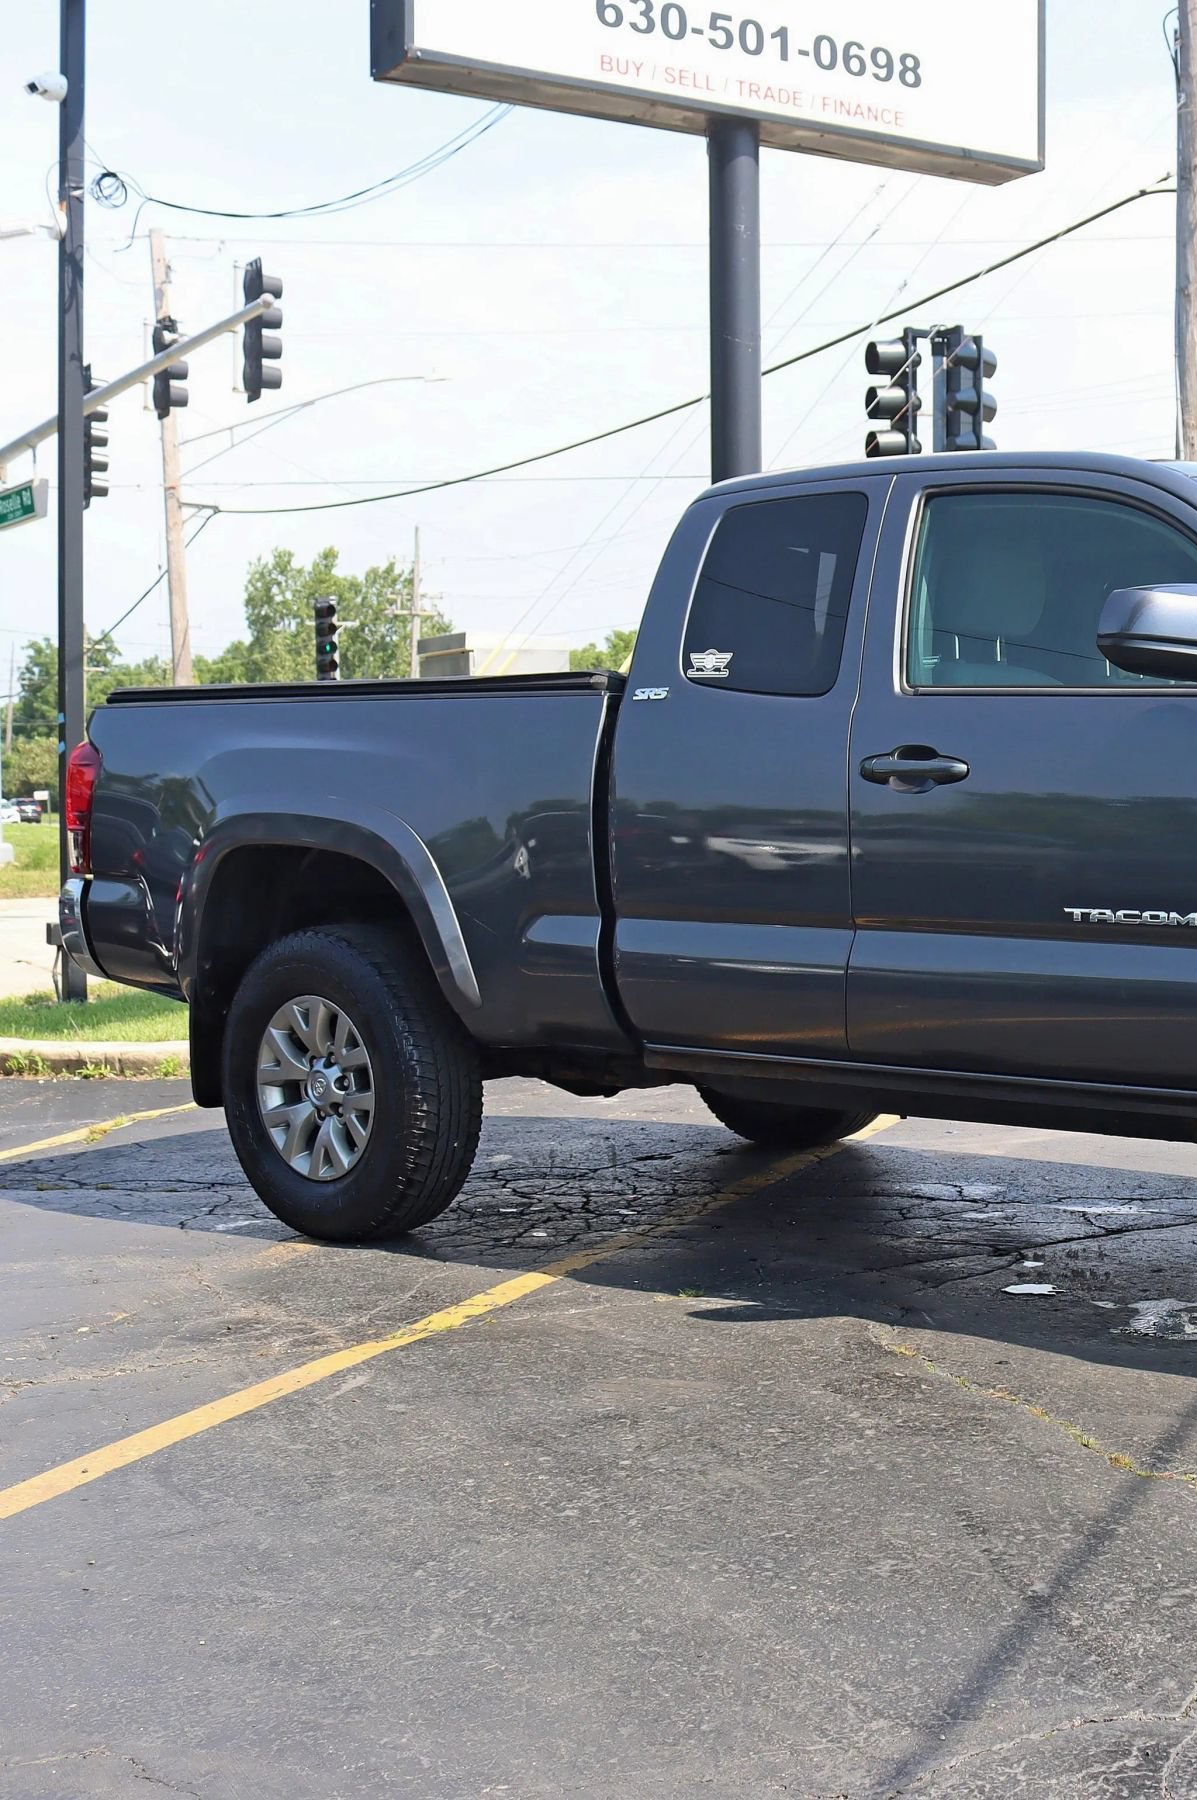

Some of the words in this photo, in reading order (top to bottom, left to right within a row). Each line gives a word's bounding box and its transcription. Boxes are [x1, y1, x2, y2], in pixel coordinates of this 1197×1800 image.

[595, 0, 922, 89] 630-501-0698
[599, 54, 645, 78] BUY
[663, 66, 715, 92] SELL
[736, 79, 803, 108] TRADE
[821, 95, 905, 128] FINANCE
[633, 687, 669, 700] SR5
